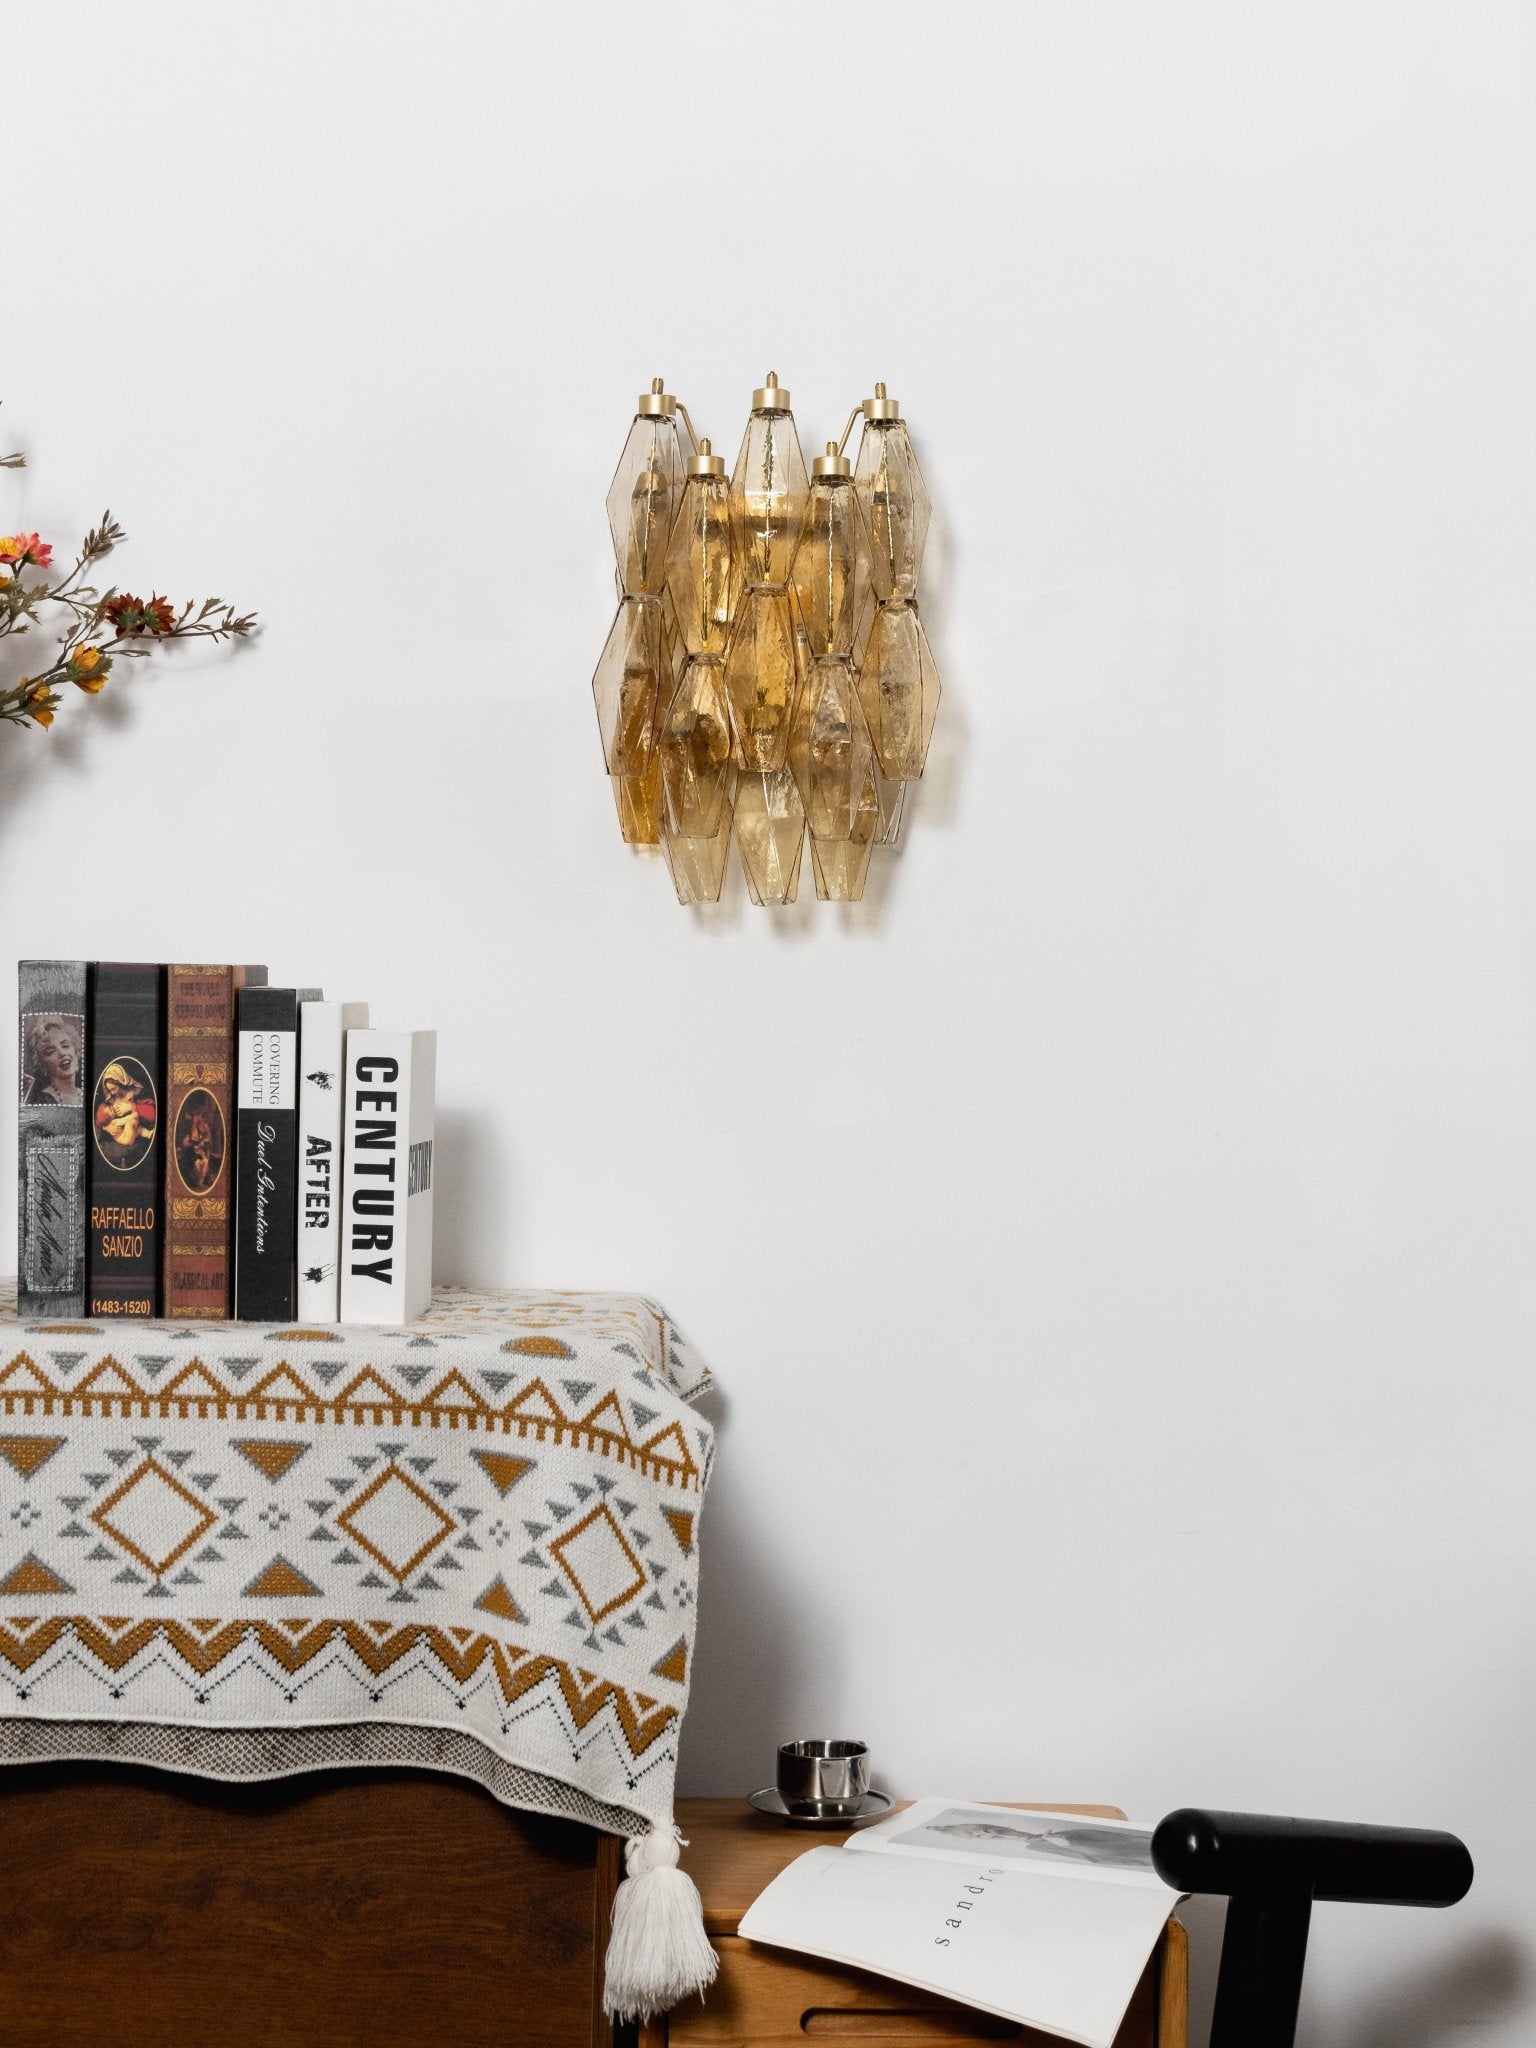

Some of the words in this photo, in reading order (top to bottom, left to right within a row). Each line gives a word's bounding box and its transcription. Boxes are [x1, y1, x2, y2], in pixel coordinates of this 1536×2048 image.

[252, 1034, 263, 1104] COMMUTE
[269, 1034, 280, 1105] COVERING
[257, 1121, 276, 1169] Duel
[351, 1056, 399, 1285] CENTURY
[256, 1168, 275, 1254] Intentions
[305, 1134, 332, 1229] AFTER
[91, 1207, 155, 1230] RAFFAELLO
[102, 1235, 143, 1258] SANZIO
[92, 1299, 151, 1315] (1483-1520)
[935, 1868, 1004, 1947] sandro
